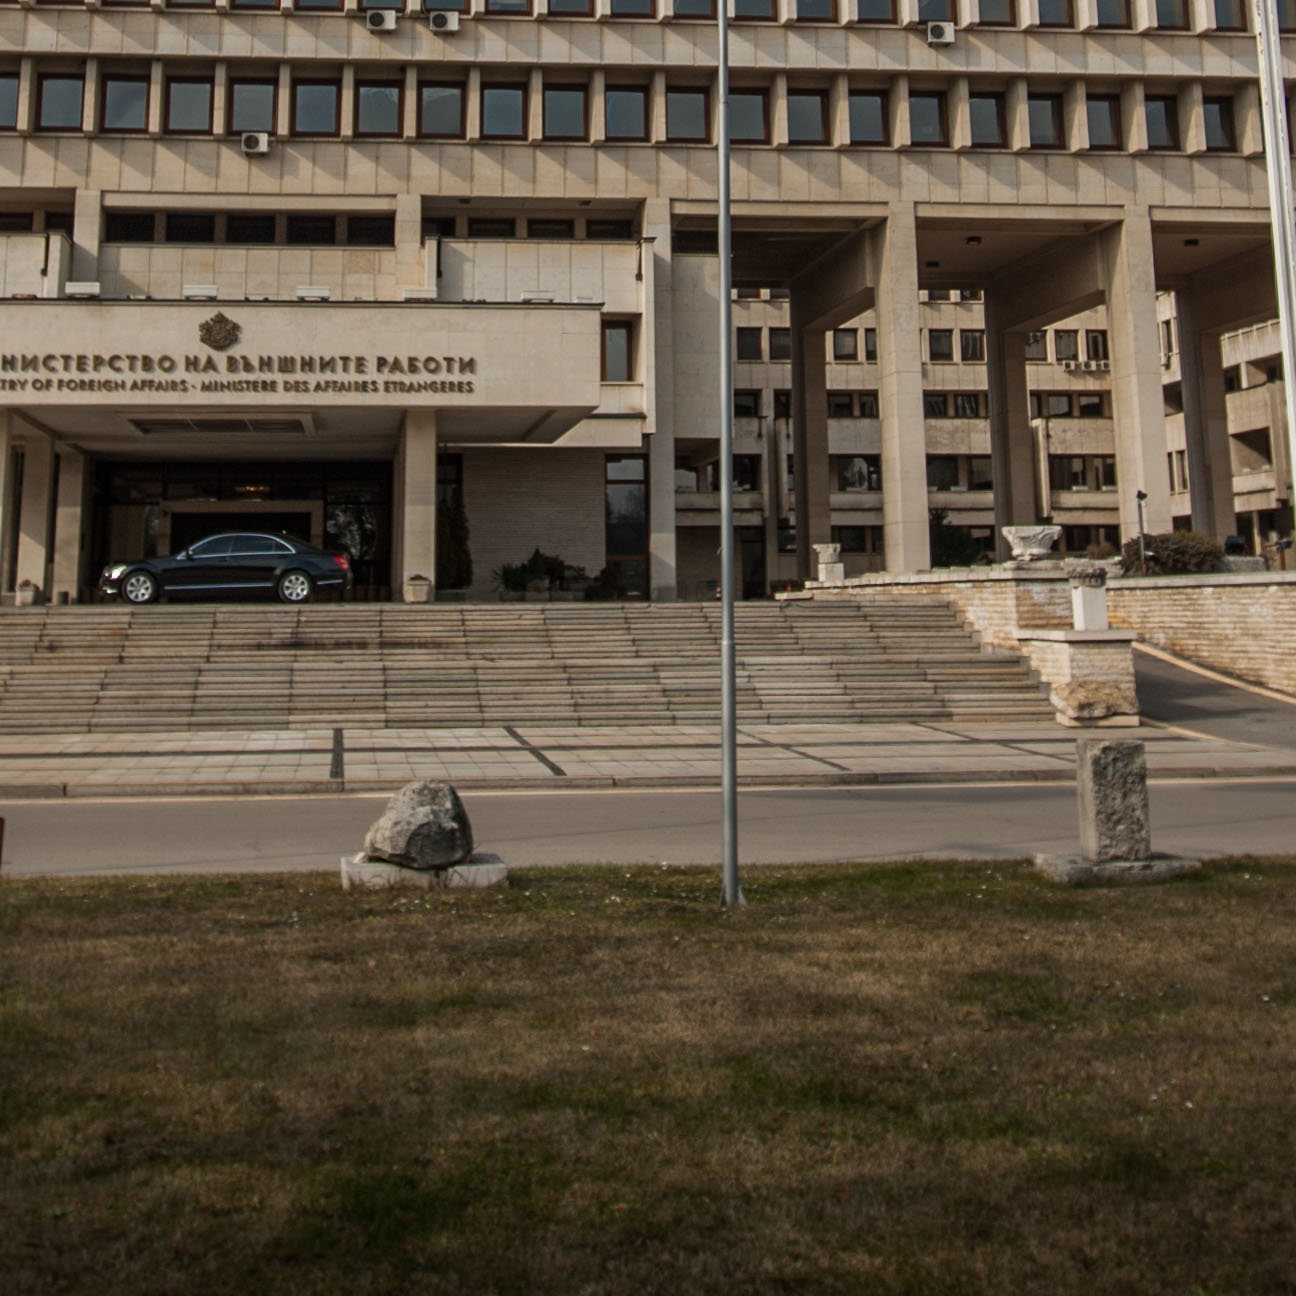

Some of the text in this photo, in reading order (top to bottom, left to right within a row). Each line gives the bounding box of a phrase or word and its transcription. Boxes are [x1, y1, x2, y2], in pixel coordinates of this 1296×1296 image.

[184, 355, 218, 373] НА
[226, 355, 368, 373] ВЪНШНИТЕ
[376, 356, 476, 374] РАБОТИ
[31, 379, 54, 392] OF
[57, 379, 126, 392] FOREIGN
[129, 379, 188, 392] AFFAIRS
[200, 379, 278, 392] MINISTERE
[282, 380, 310, 392] DES
[313, 380, 379, 393] AFFAIRES
[384, 380, 475, 393] ETRANGERES
